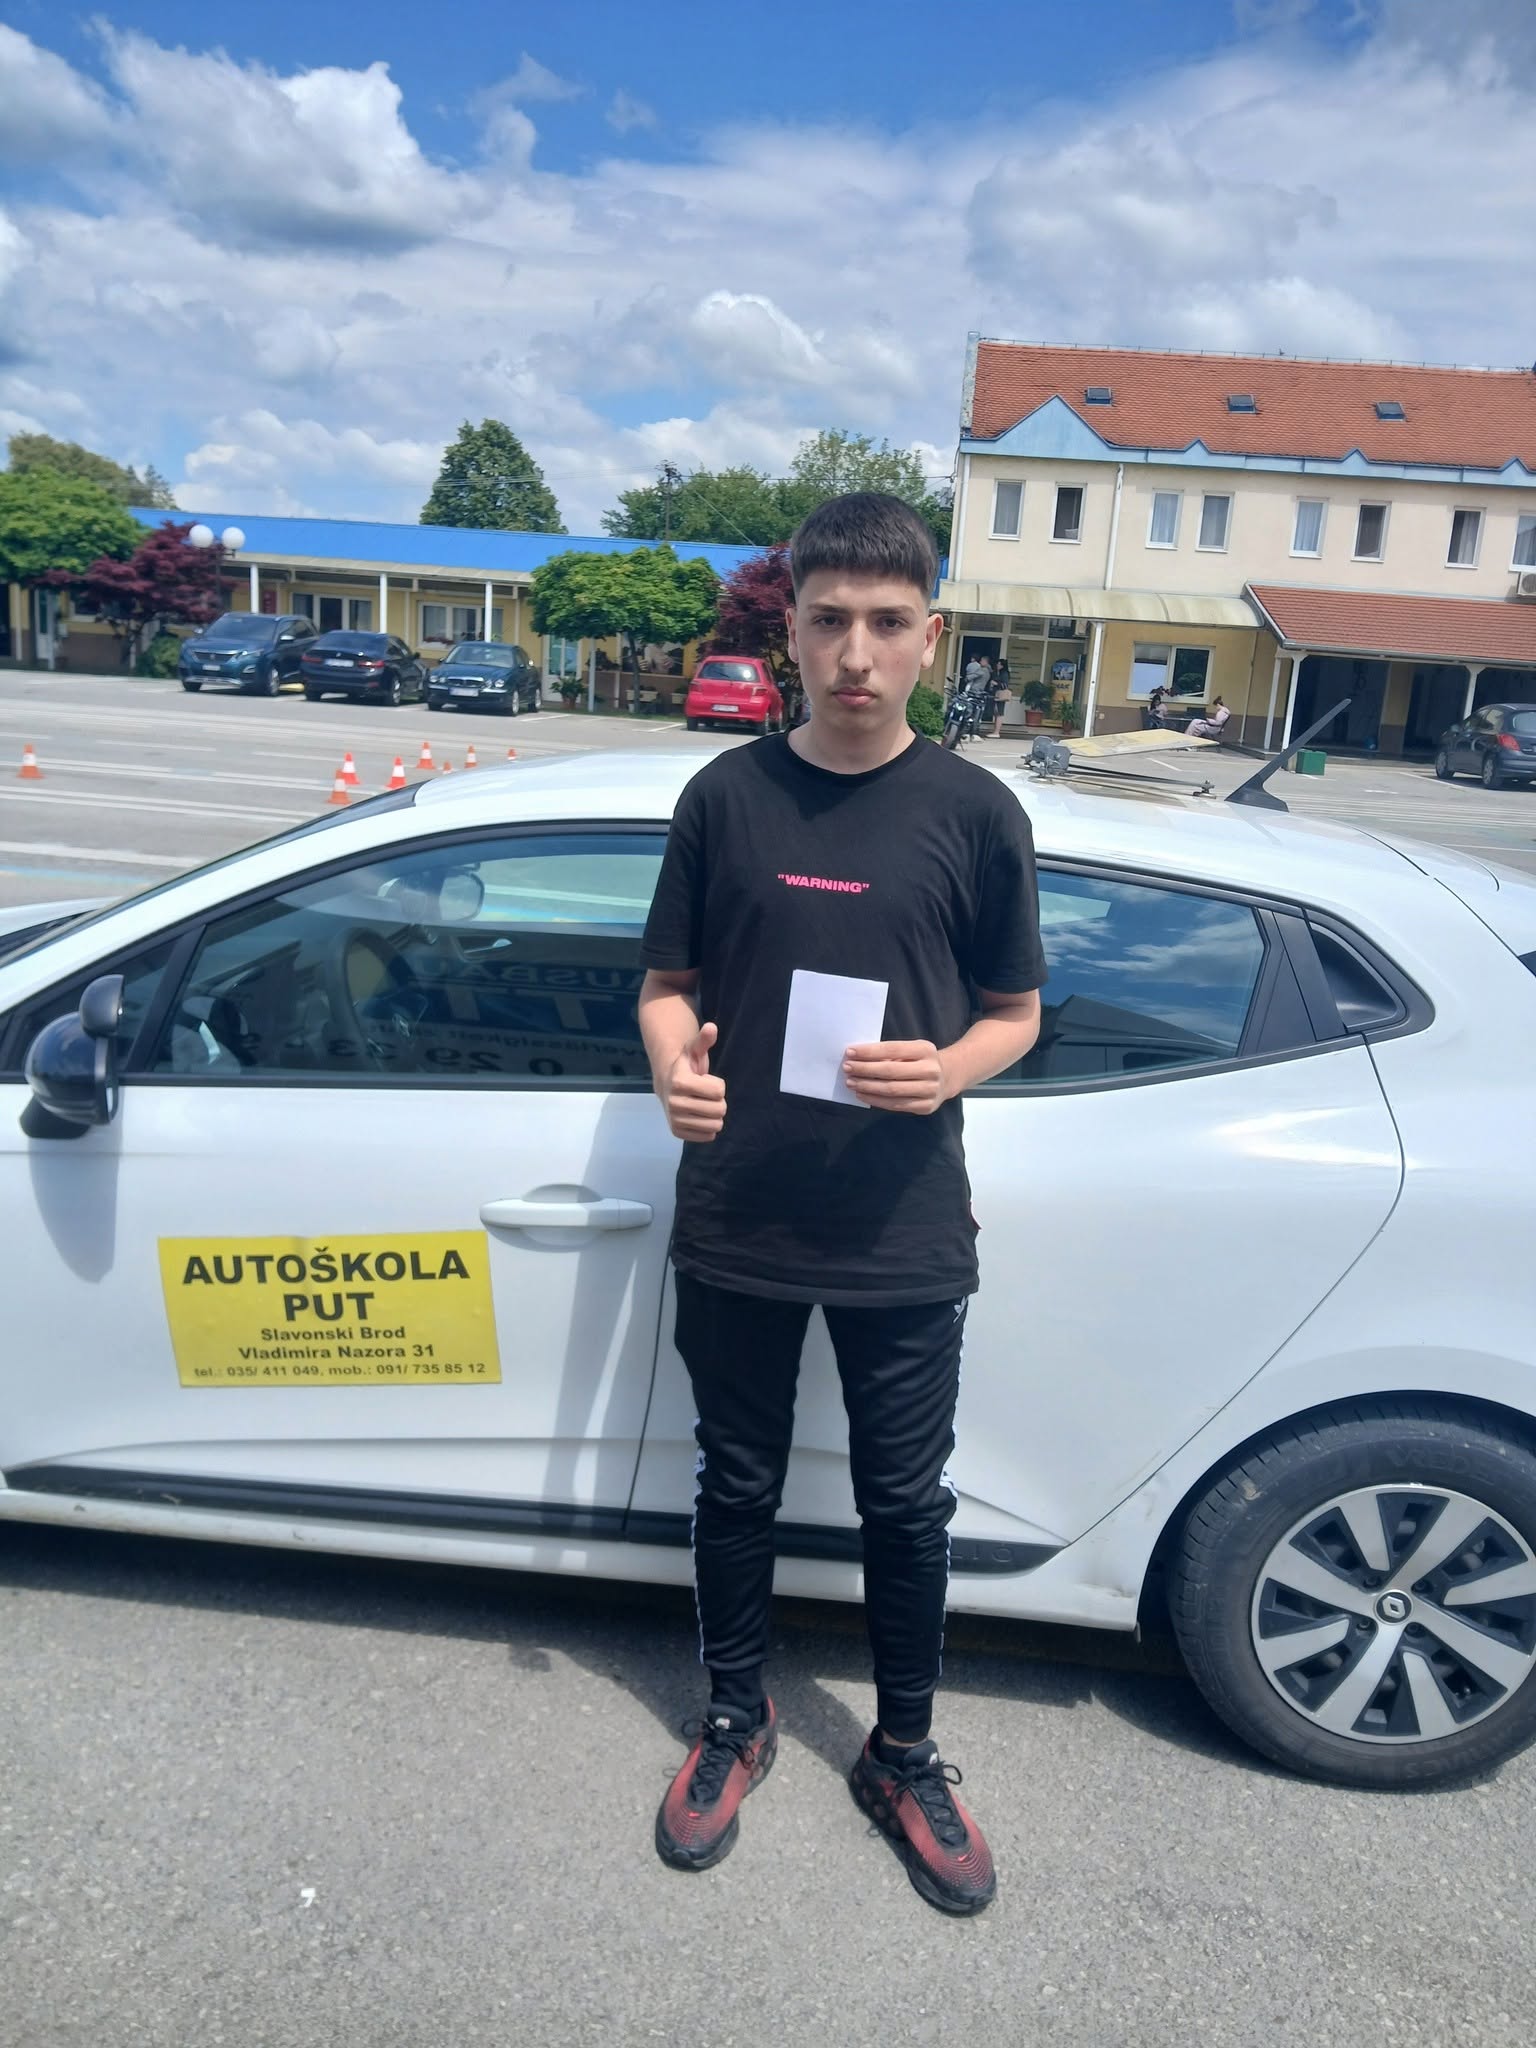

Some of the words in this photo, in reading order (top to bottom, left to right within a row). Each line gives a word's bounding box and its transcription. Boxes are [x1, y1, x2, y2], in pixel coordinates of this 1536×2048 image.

[777, 873, 870, 893] "WARNING"
[182, 1247, 470, 1284] AUTOŠKOLA
[283, 1291, 375, 1322] PUT
[260, 1326, 353, 1341] Slavonski
[360, 1325, 406, 1340] Brod
[238, 1345, 331, 1360] Vladimira
[337, 1345, 406, 1358] Nazora
[412, 1344, 435, 1358] 31
[262, 1365, 287, 1376] 411
[376, 1363, 408, 1375] 091/
[413, 1363, 440, 1374] 735
[444, 1363, 463, 1374] 85
[468, 1362, 486, 1374] 12
